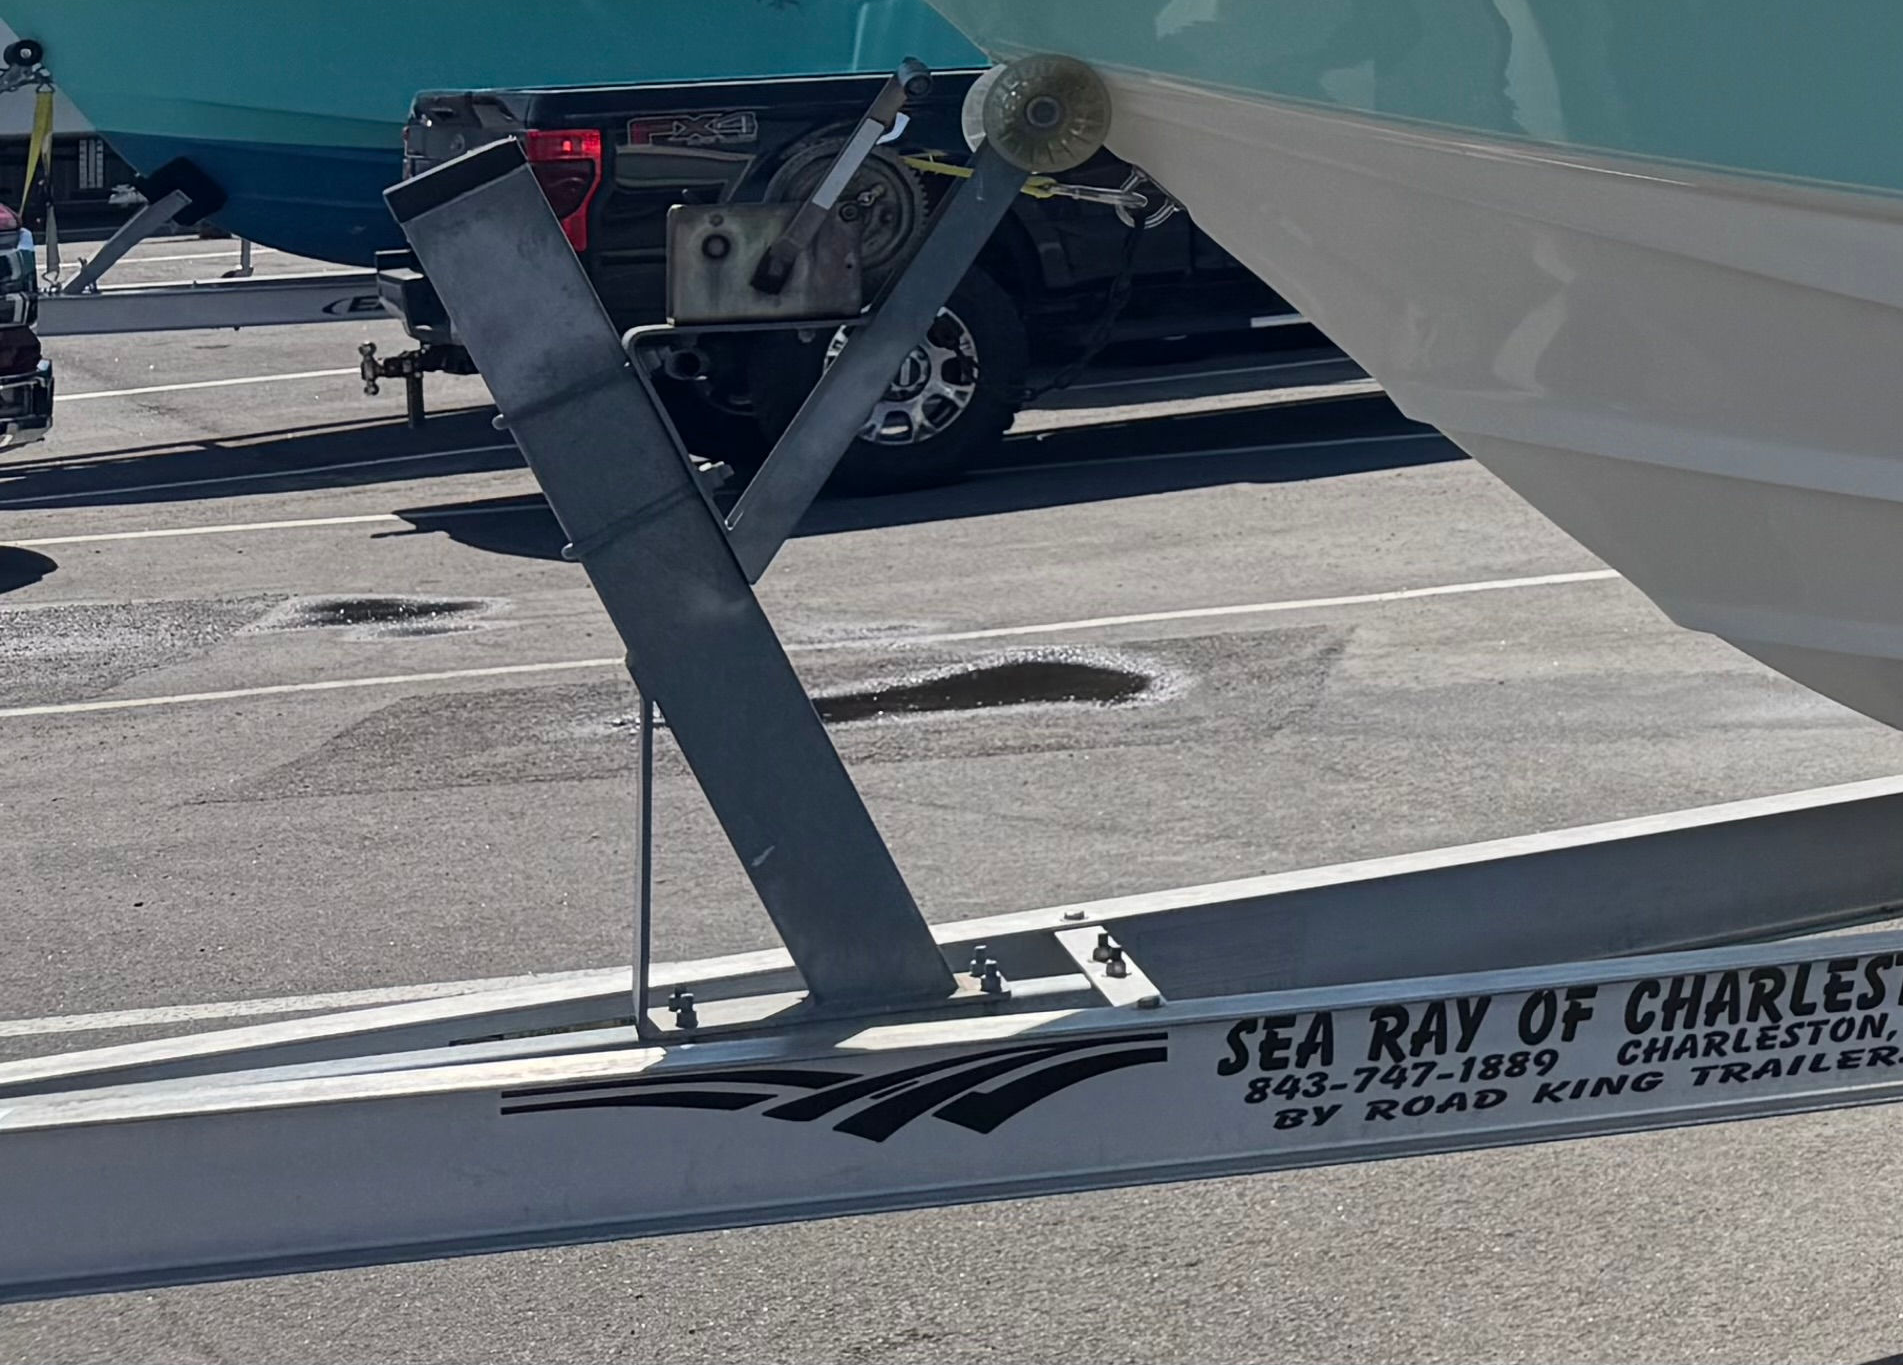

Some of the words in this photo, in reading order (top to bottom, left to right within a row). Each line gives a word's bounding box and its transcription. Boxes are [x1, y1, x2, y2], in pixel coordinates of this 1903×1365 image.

[627, 111, 758, 146] FX4
[1217, 1011, 1335, 1077] SEA
[1368, 995, 1492, 1063] RAY
[1518, 986, 1599, 1047] OF
[1244, 1049, 1559, 1104] 843-747-1889
[1617, 1012, 1898, 1066] CHARLESTON,
[1273, 1104, 1342, 1130] BY
[1364, 1088, 1507, 1122] ROAD
[1532, 1071, 1664, 1104] KING
